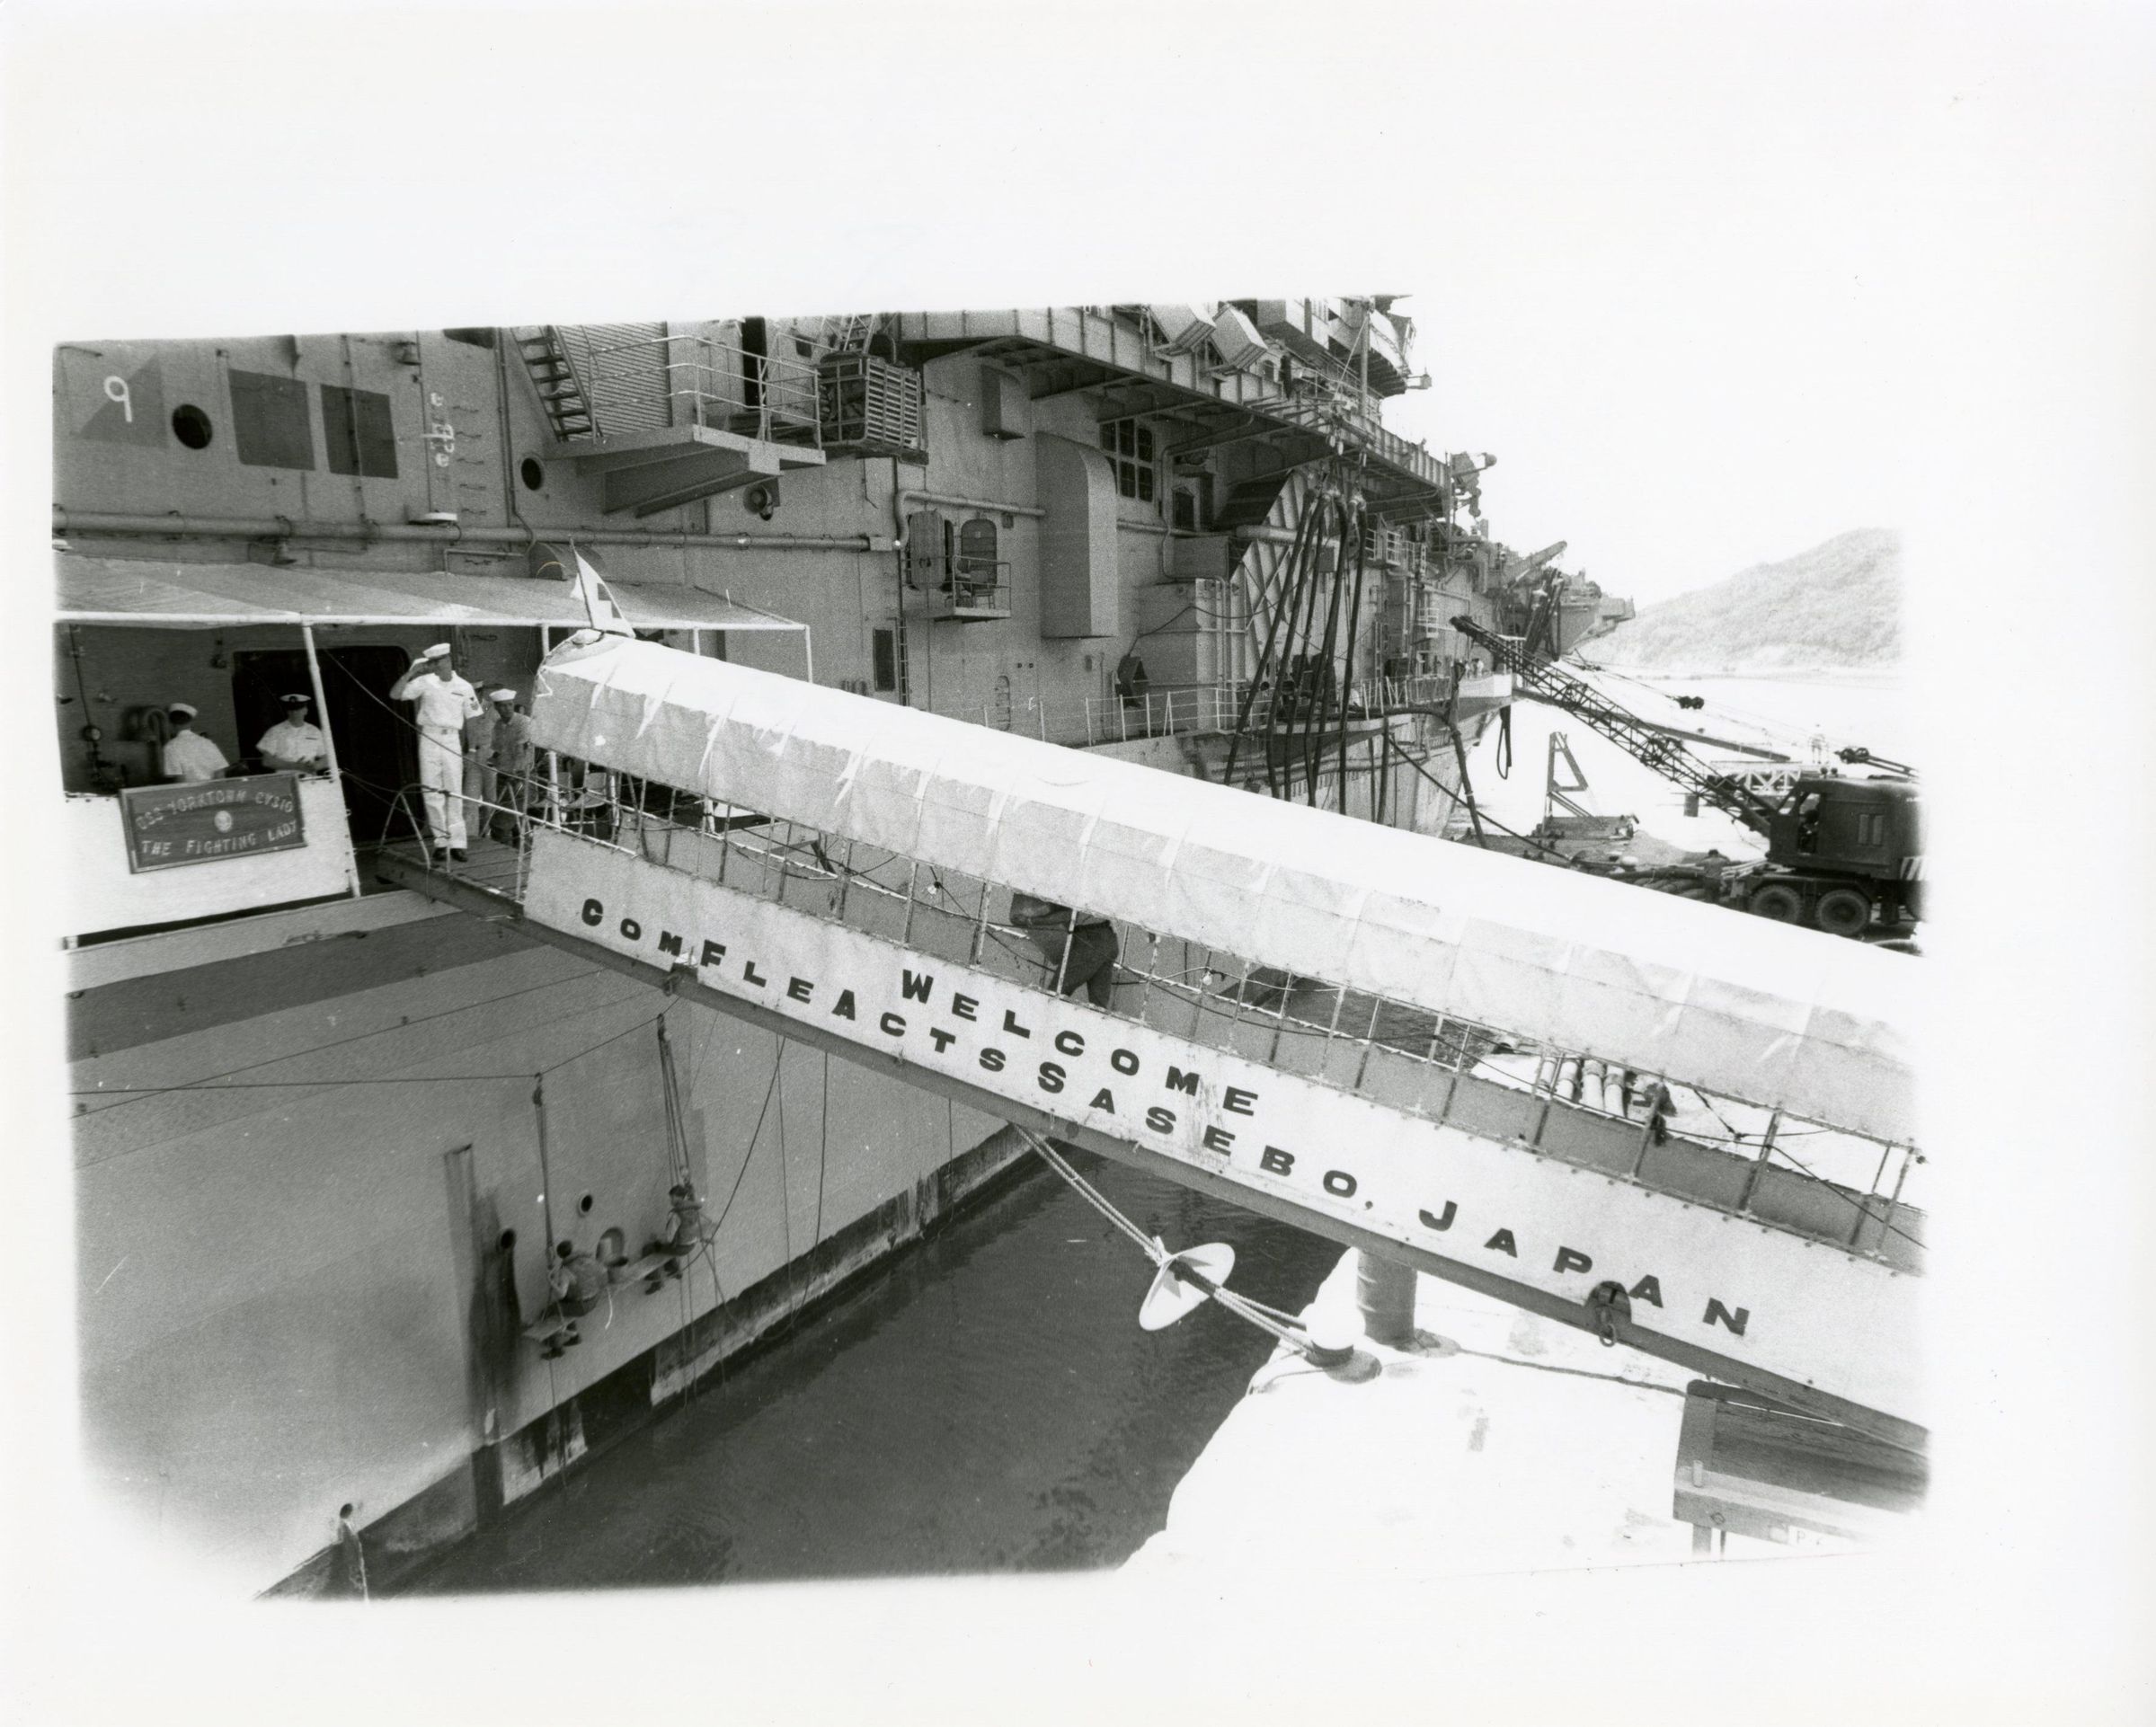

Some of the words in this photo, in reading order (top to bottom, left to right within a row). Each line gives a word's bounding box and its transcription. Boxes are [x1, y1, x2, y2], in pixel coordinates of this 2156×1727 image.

[141, 840, 173, 856] THE
[185, 832, 257, 855] FIGHTING
[267, 819, 297, 843] LADY
[167, 789, 248, 816] YORKTOWN
[902, 969, 1258, 1116] WELCOME
[1418, 1200, 1751, 1337] JAPAN
